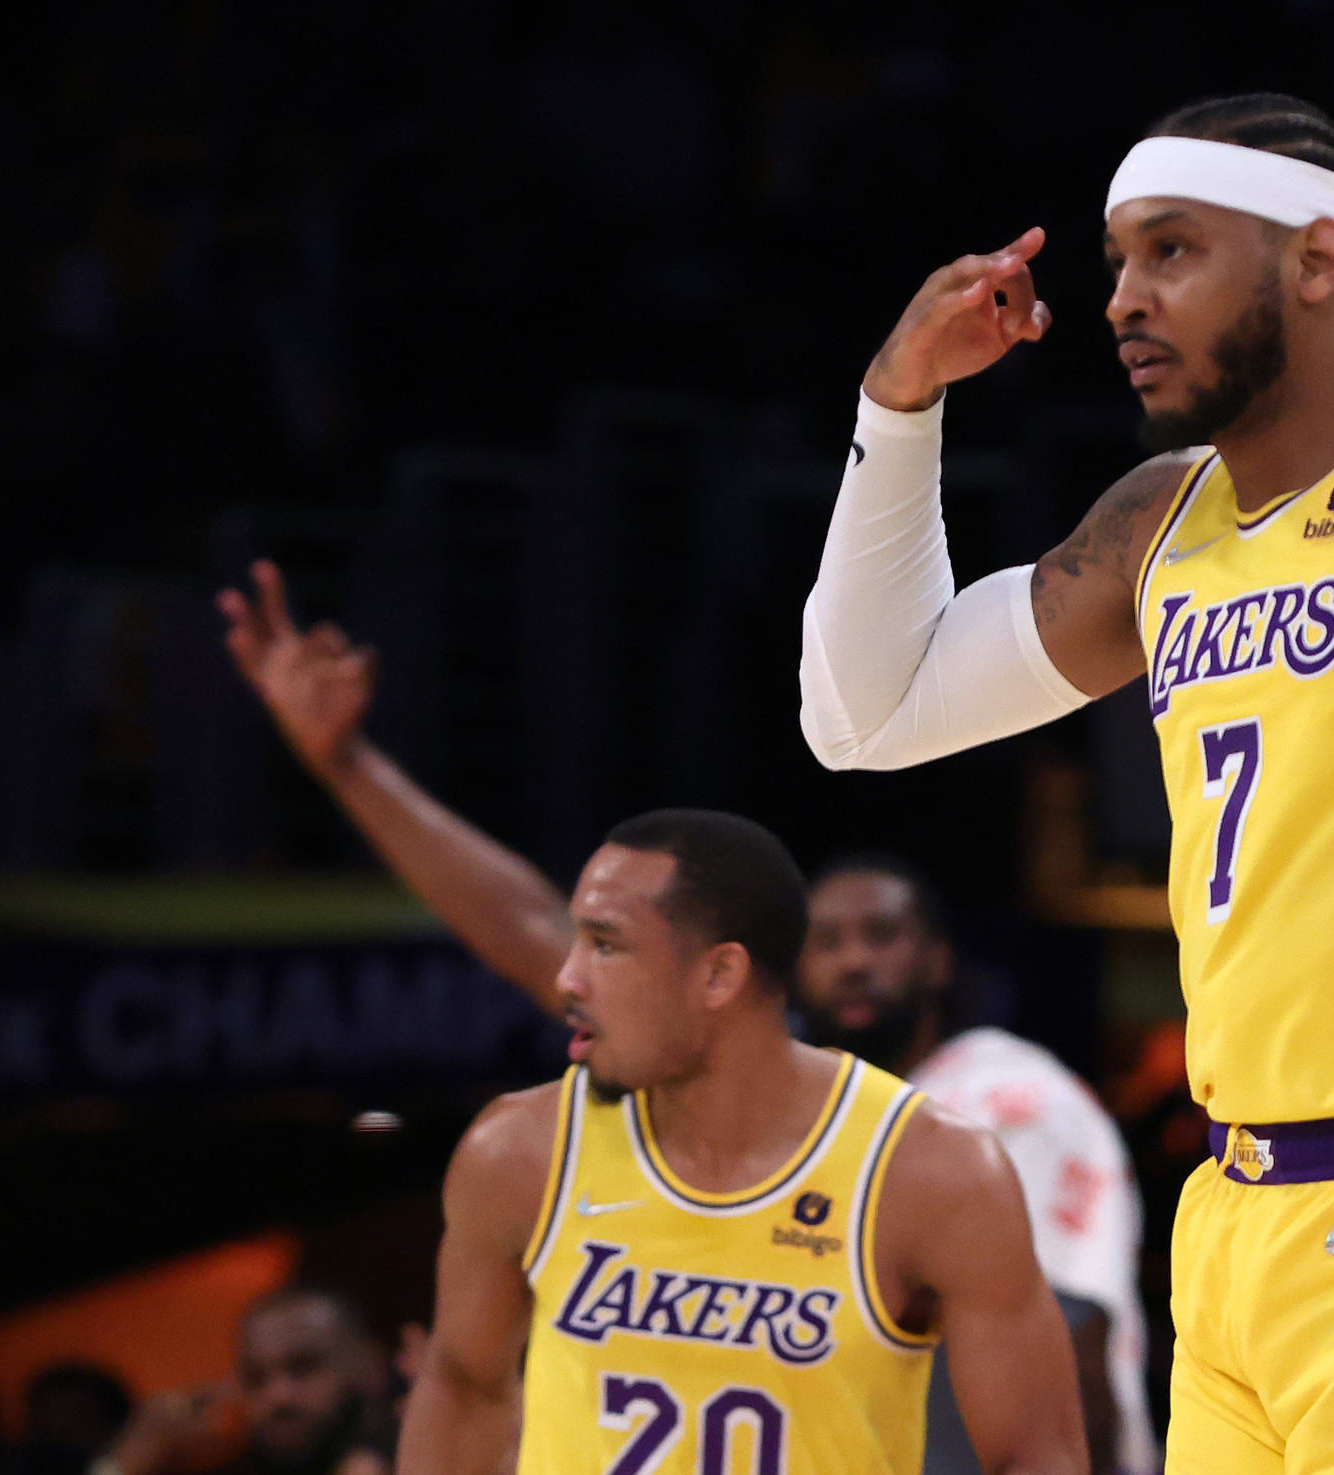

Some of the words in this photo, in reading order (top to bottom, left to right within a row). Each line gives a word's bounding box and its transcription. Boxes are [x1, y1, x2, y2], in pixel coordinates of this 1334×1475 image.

[1197, 715, 1263, 925] 7
[75, 953, 566, 1083] CHAMP
[552, 1240, 840, 1366] LAKERS
